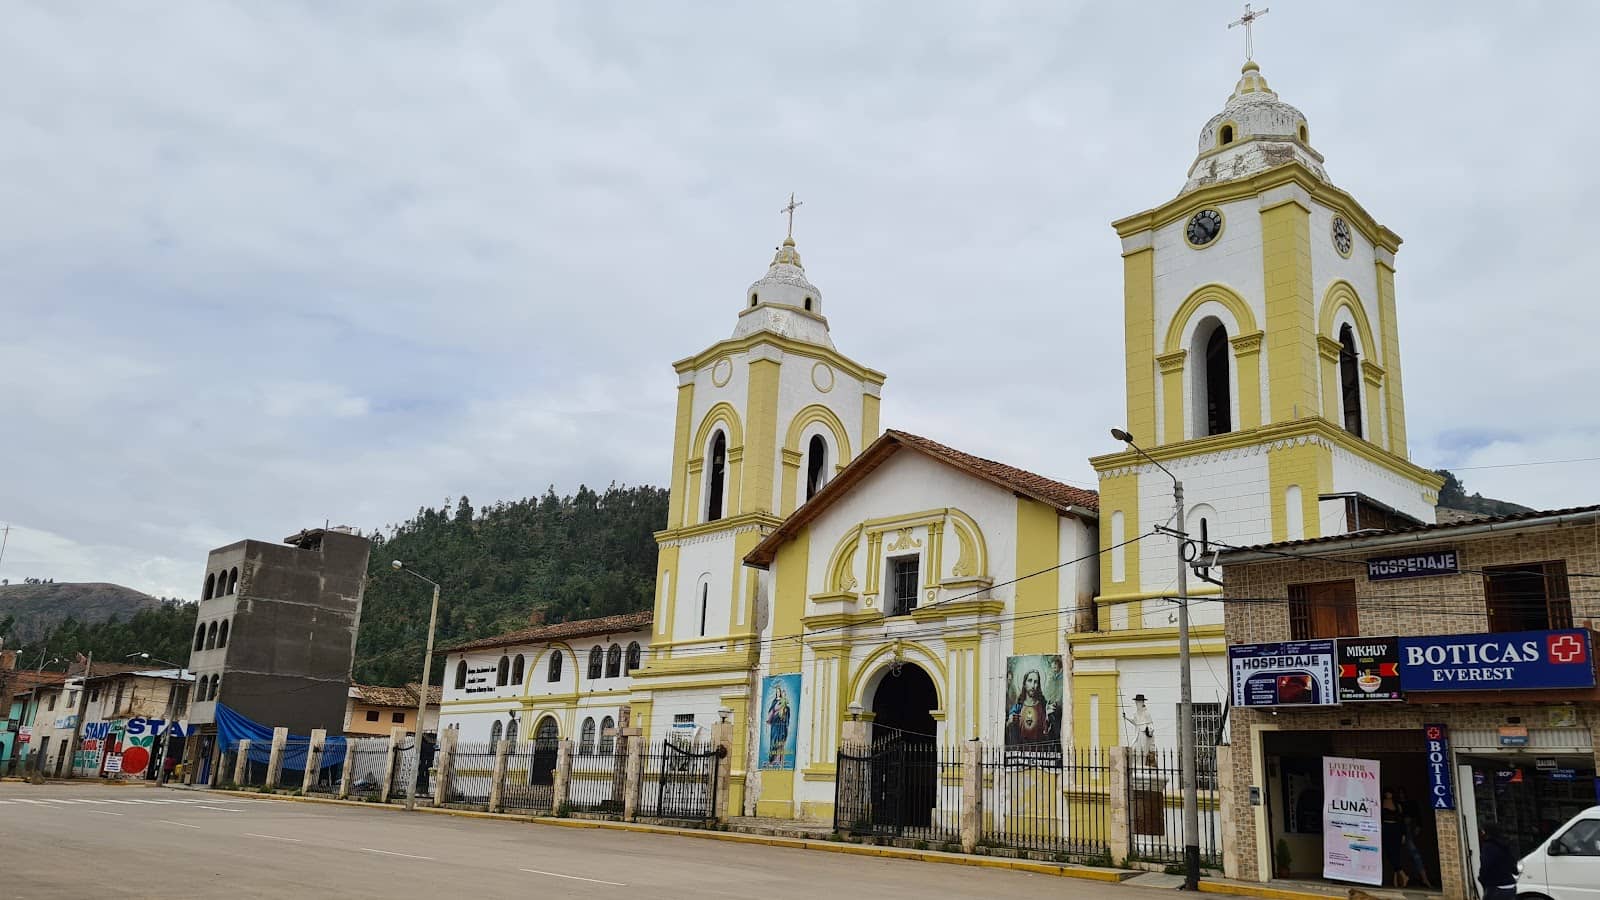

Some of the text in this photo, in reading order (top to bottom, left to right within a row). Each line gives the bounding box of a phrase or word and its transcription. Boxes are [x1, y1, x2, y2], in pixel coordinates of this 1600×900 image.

[1369, 553, 1456, 576] HOSPEDAJE
[1346, 644, 1387, 657] MIKHUY
[1405, 641, 1540, 666] BOTICAS
[1243, 655, 1320, 670] HOSPEDAJE
[1432, 667, 1514, 682] EVEREST
[1329, 769, 1376, 780] FASHION
[1430, 741, 1448, 808] BOTICA
[1332, 799, 1368, 813] LUNA
